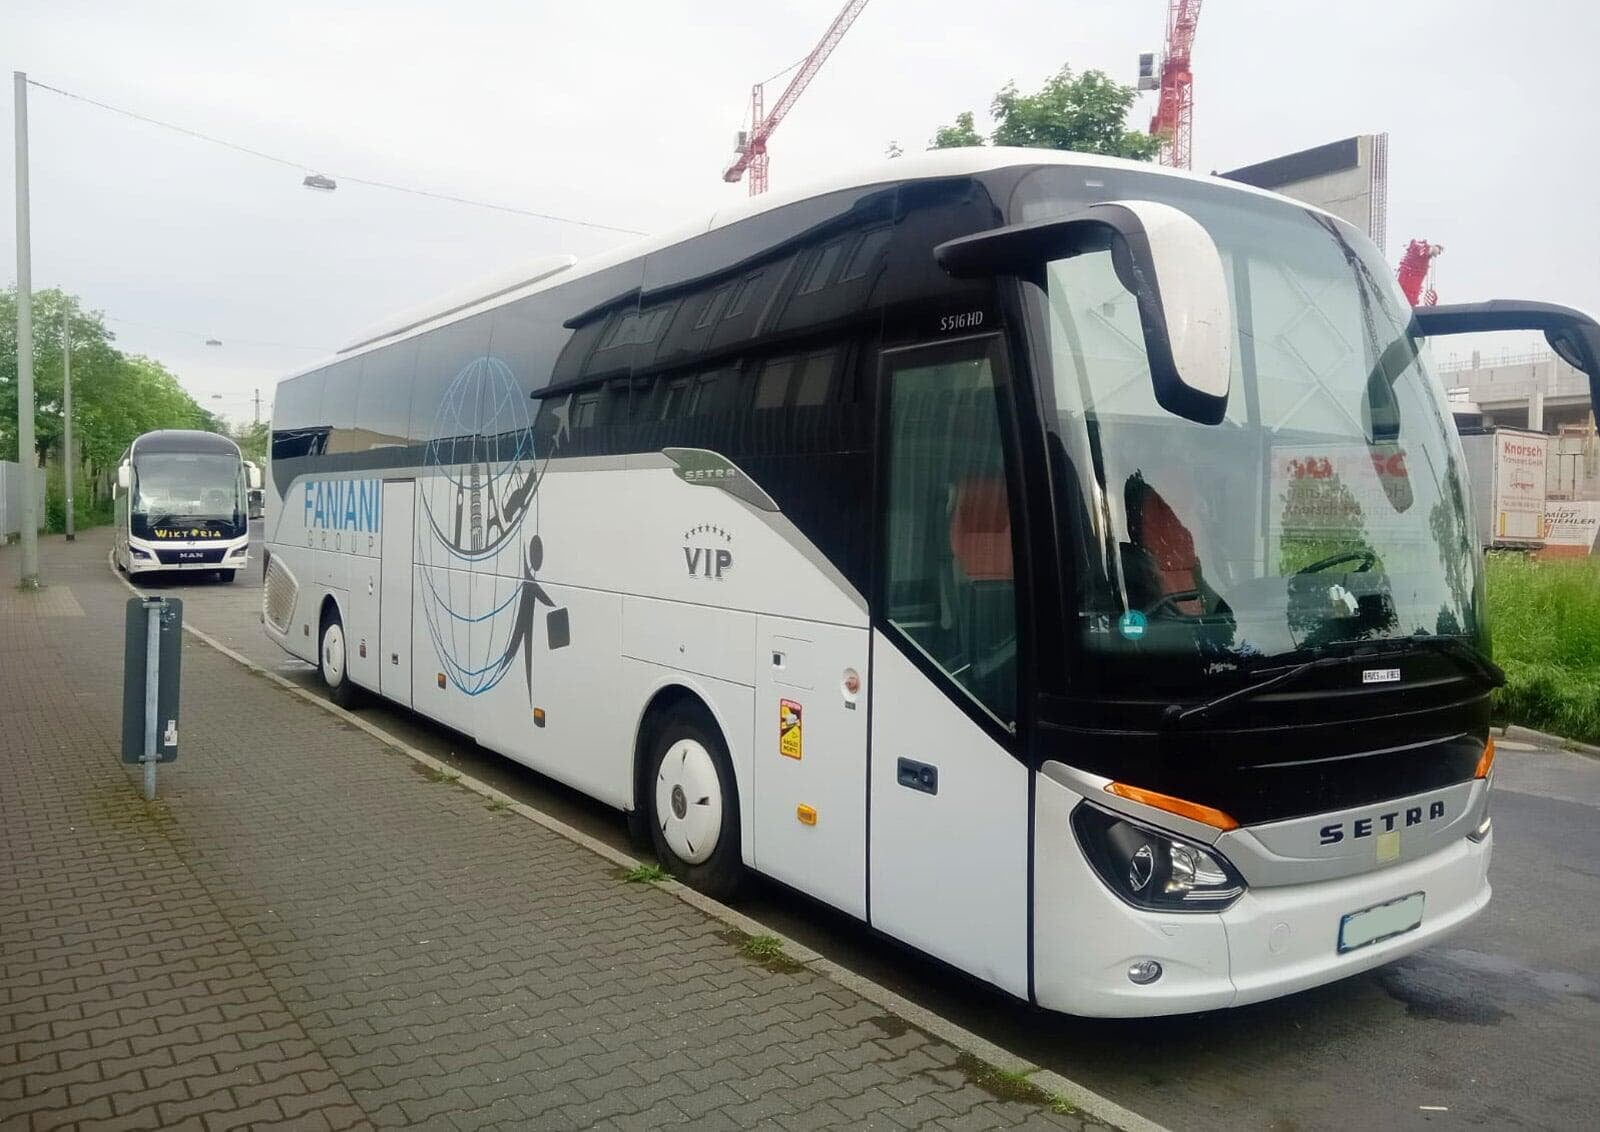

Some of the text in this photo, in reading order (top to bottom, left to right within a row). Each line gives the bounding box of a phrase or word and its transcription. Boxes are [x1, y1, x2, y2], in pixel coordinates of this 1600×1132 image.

[1504, 442, 1542, 457] Knorsch
[684, 468, 737, 480] SETRA
[304, 479, 379, 533] FANIANI
[154, 528, 222, 538] WIKTORIA
[307, 529, 375, 557] GROUP
[683, 546, 733, 578] VIP
[1320, 801, 1445, 845] SETRA
